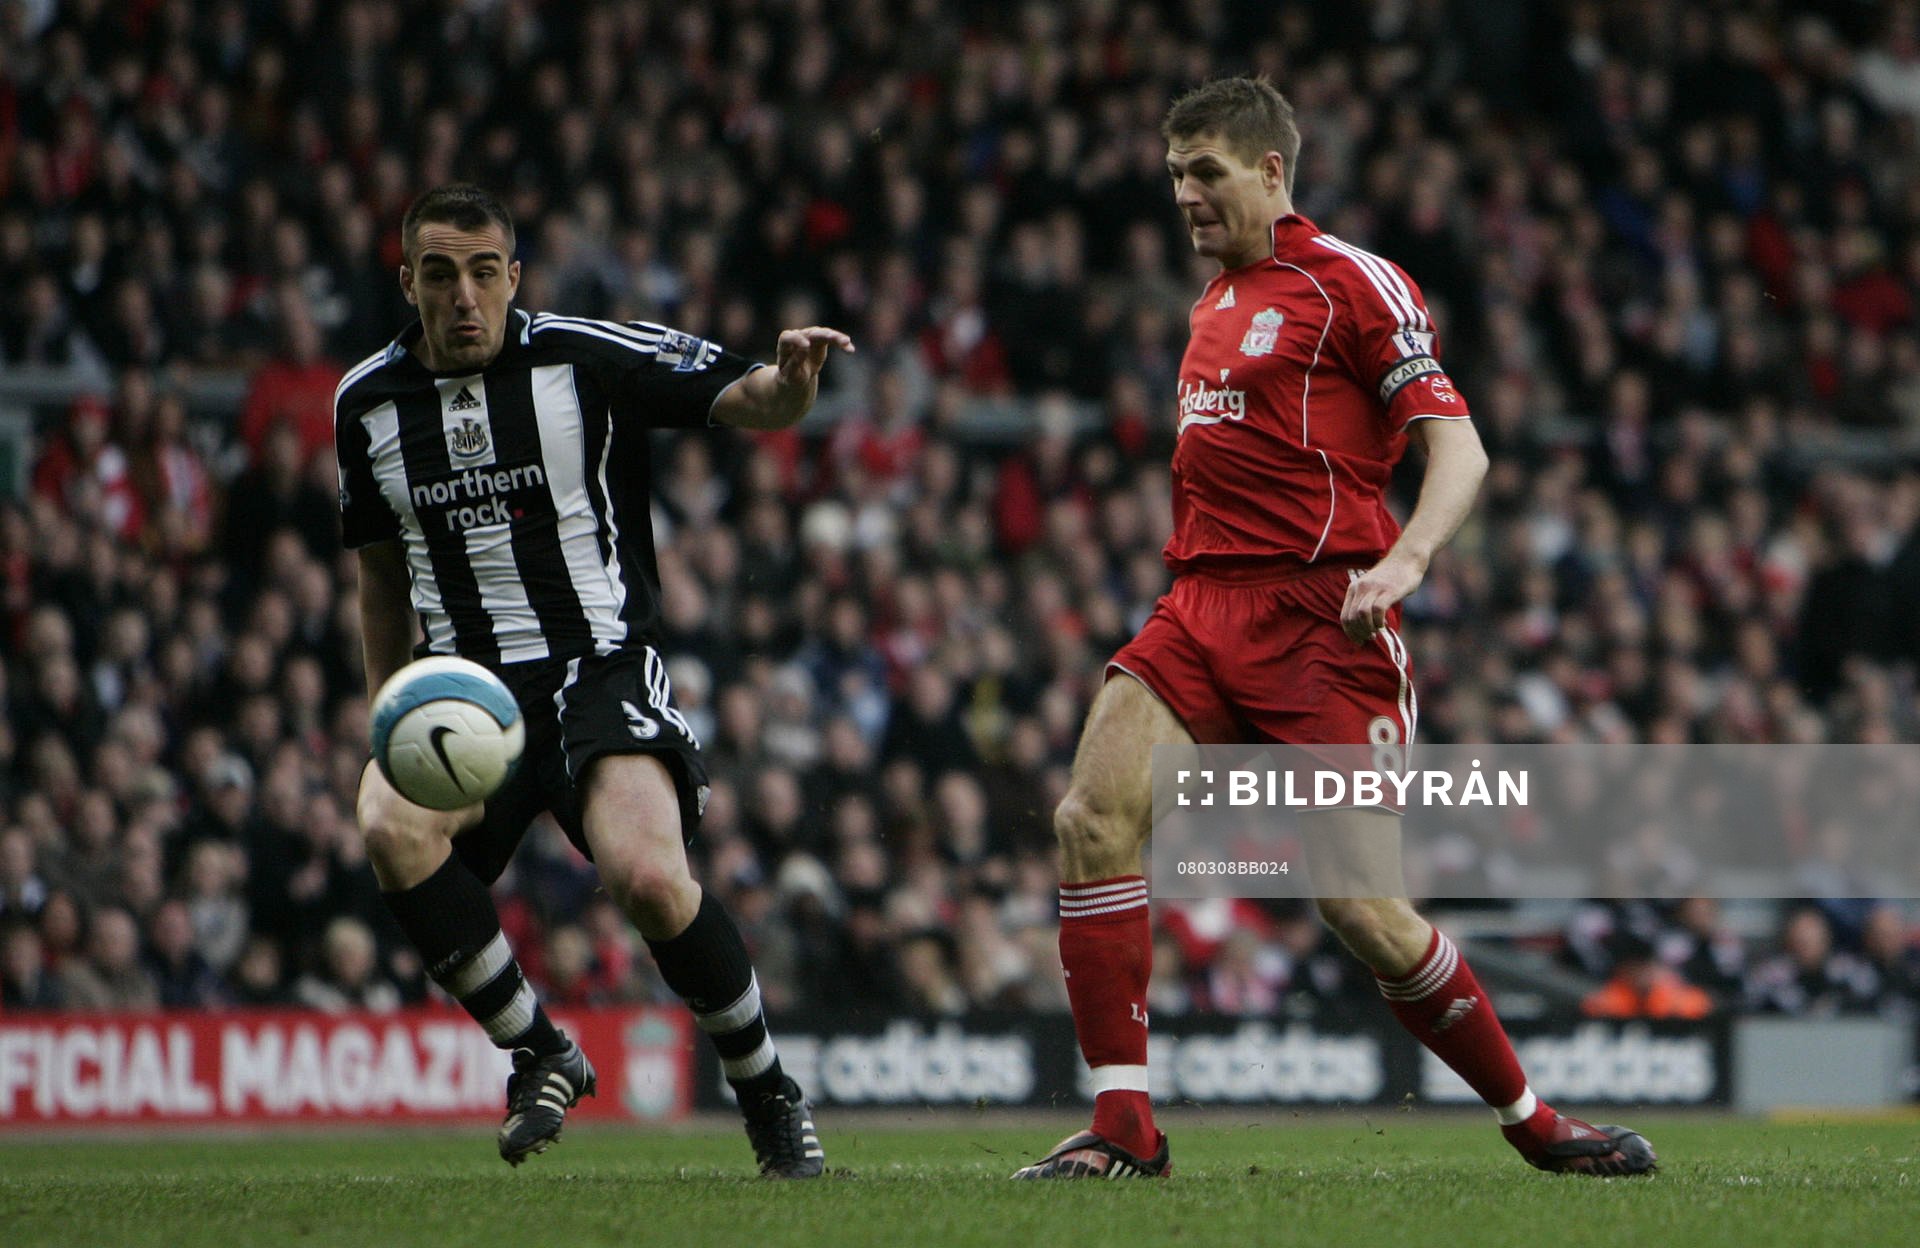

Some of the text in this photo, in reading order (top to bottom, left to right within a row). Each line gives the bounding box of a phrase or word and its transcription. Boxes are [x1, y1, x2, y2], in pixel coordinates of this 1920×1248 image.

[1177, 379, 1246, 434] rlsberg
[413, 464, 544, 507] northern
[1367, 715, 1404, 781] 8
[220, 1019, 580, 1113] MAGAZIN
[821, 1018, 1034, 1102] adidas
[1175, 1018, 1386, 1102] adidas
